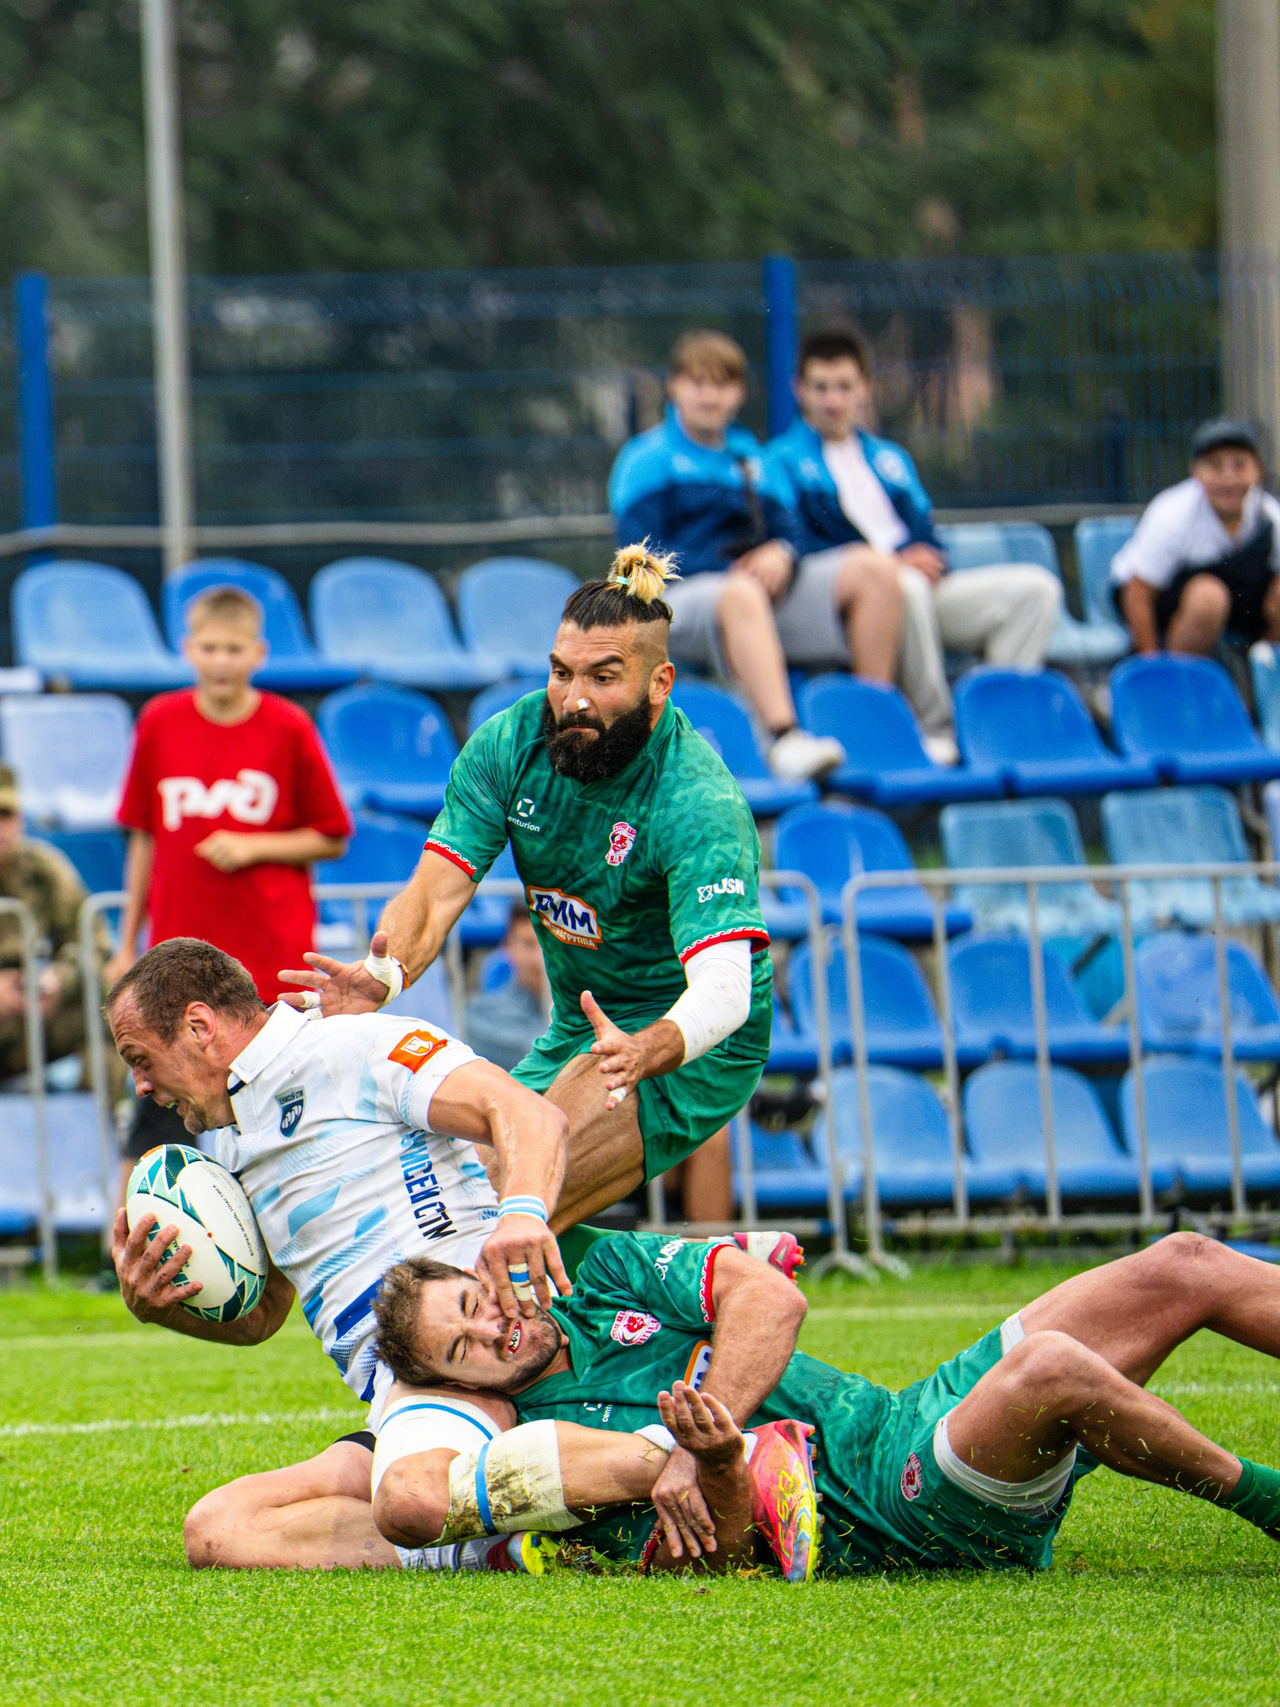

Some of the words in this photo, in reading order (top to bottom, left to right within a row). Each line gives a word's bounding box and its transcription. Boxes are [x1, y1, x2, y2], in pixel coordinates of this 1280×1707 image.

[507, 816, 540, 832] enturion
[713, 877, 745, 896] USN
[413, 1201, 458, 1241] СТМ
